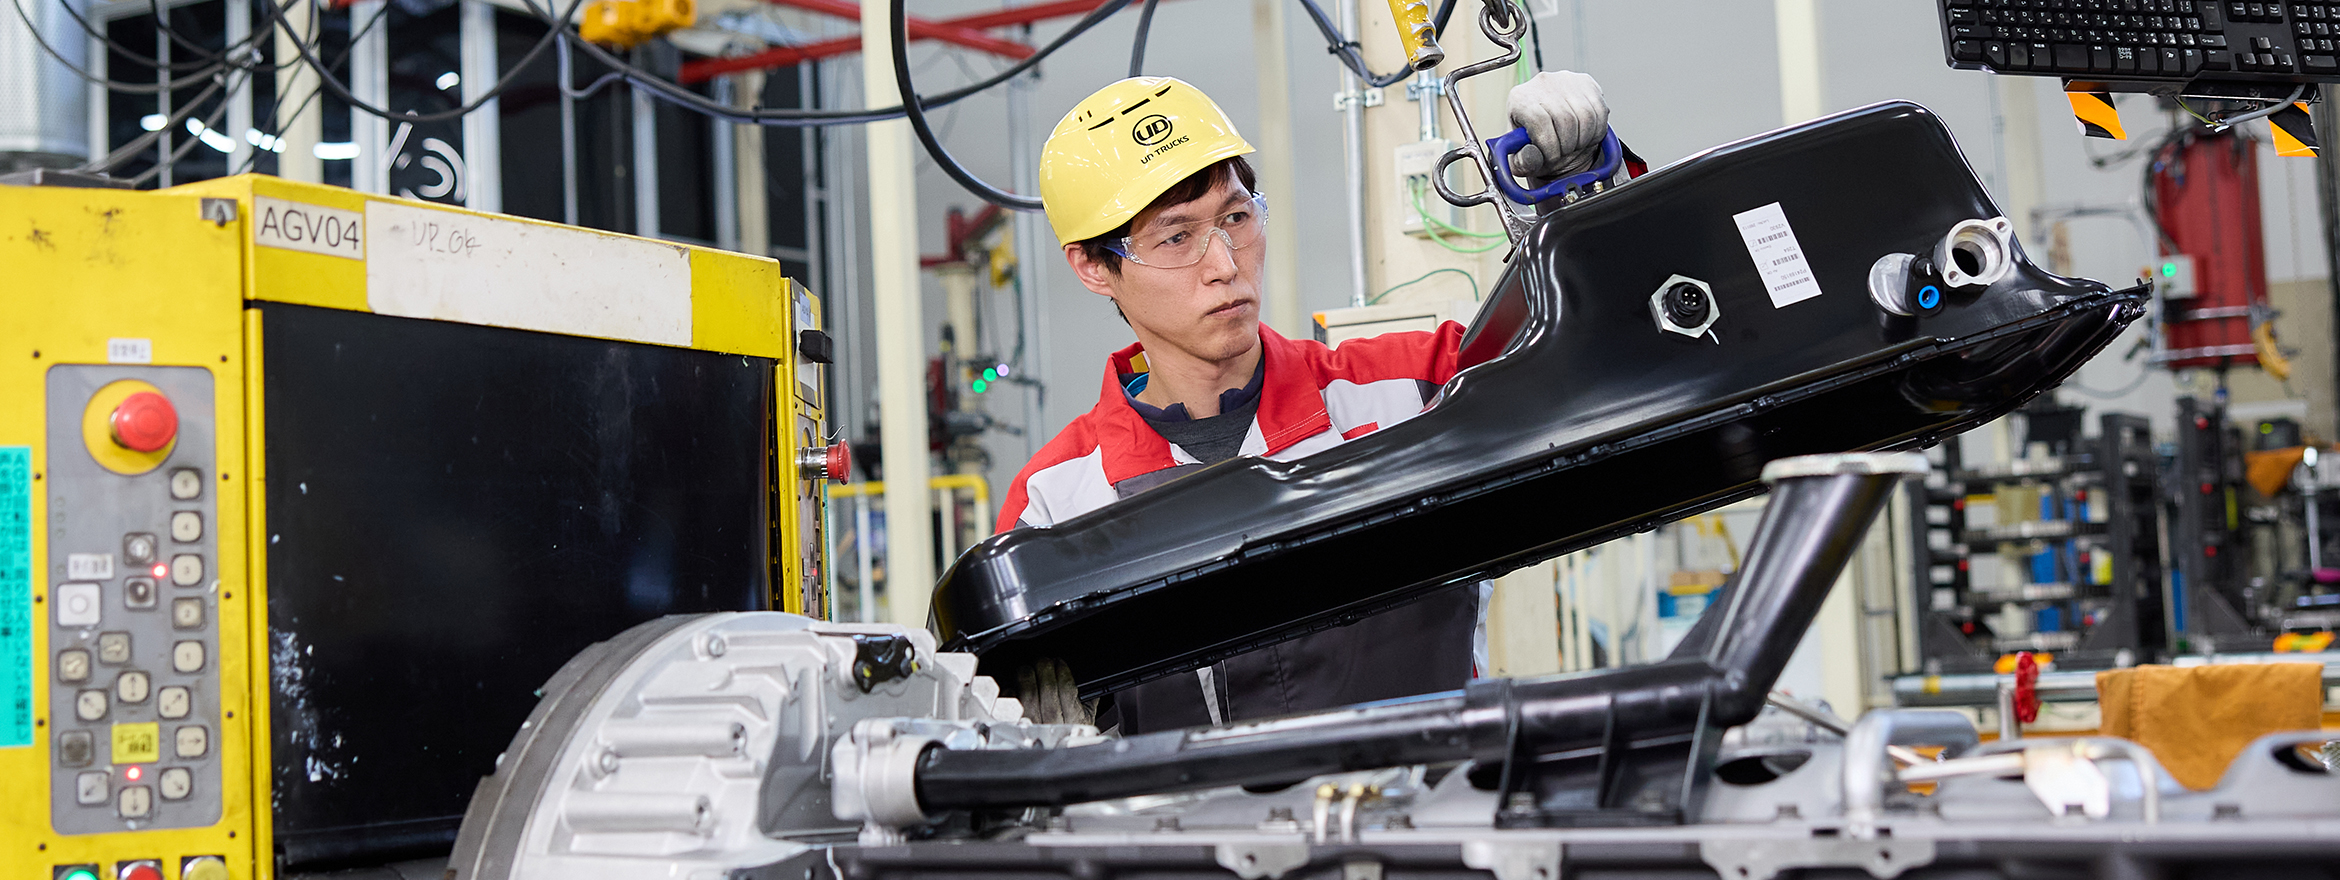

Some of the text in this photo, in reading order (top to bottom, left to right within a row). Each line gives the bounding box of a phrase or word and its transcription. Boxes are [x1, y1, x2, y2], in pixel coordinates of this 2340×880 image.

[1136, 119, 1169, 141] UD
[1154, 135, 1190, 155] TRUCKS
[260, 206, 360, 250] AGV04
